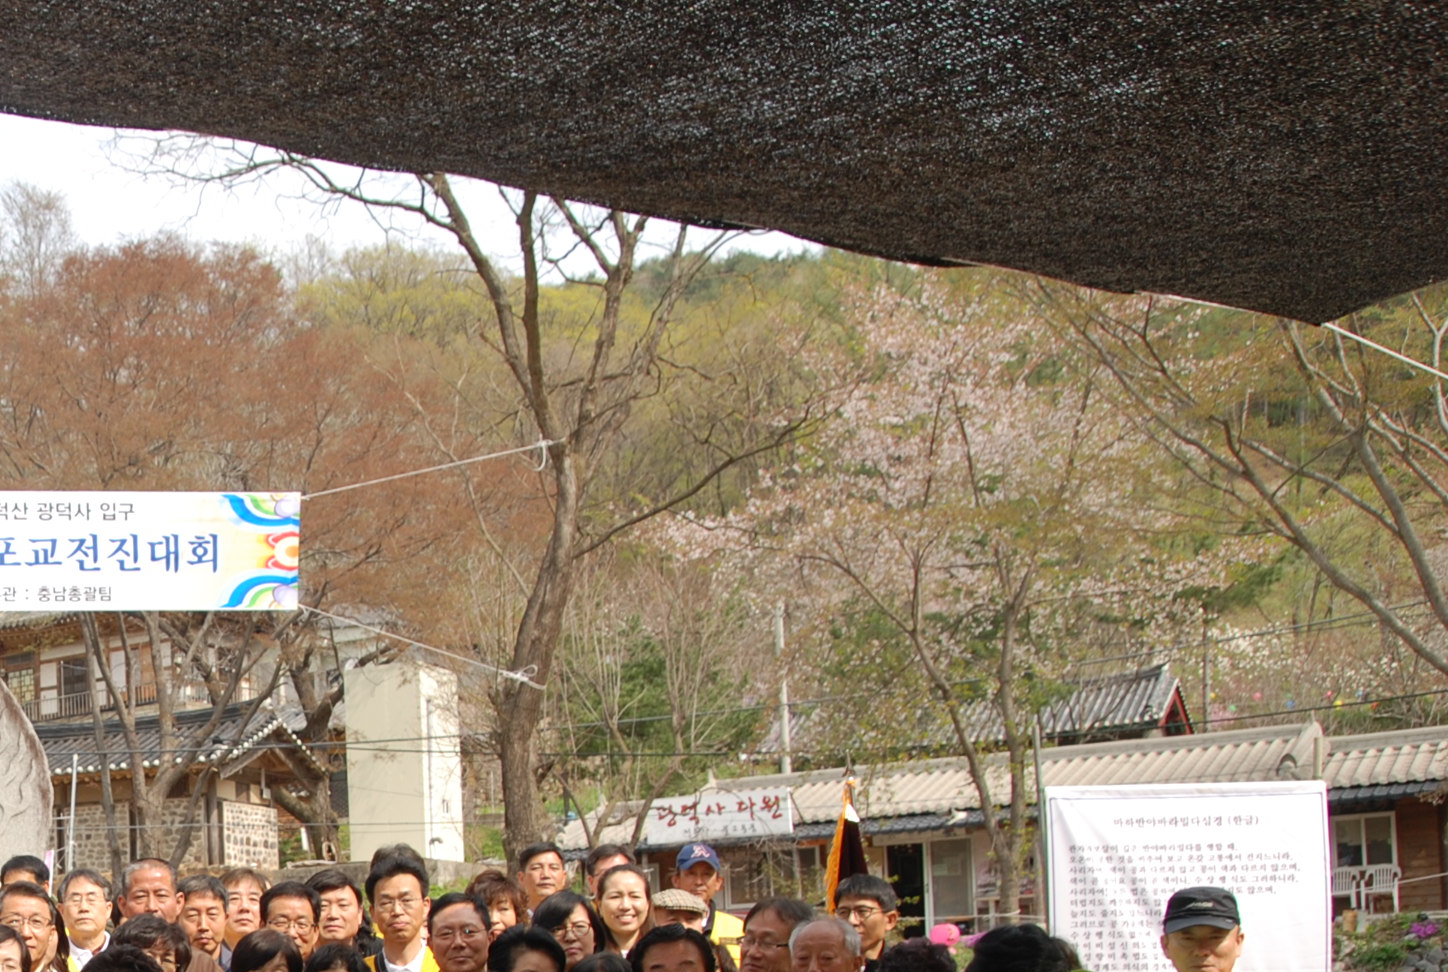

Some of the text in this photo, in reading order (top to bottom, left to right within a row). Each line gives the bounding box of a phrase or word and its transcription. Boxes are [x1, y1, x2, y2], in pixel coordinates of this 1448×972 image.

[37, 503, 91, 521] 광덕사
[100, 503, 134, 521] 입구
[38, 586, 111, 602] 충남총괄팀
[656, 796, 782, 826] 광덕사 다원
